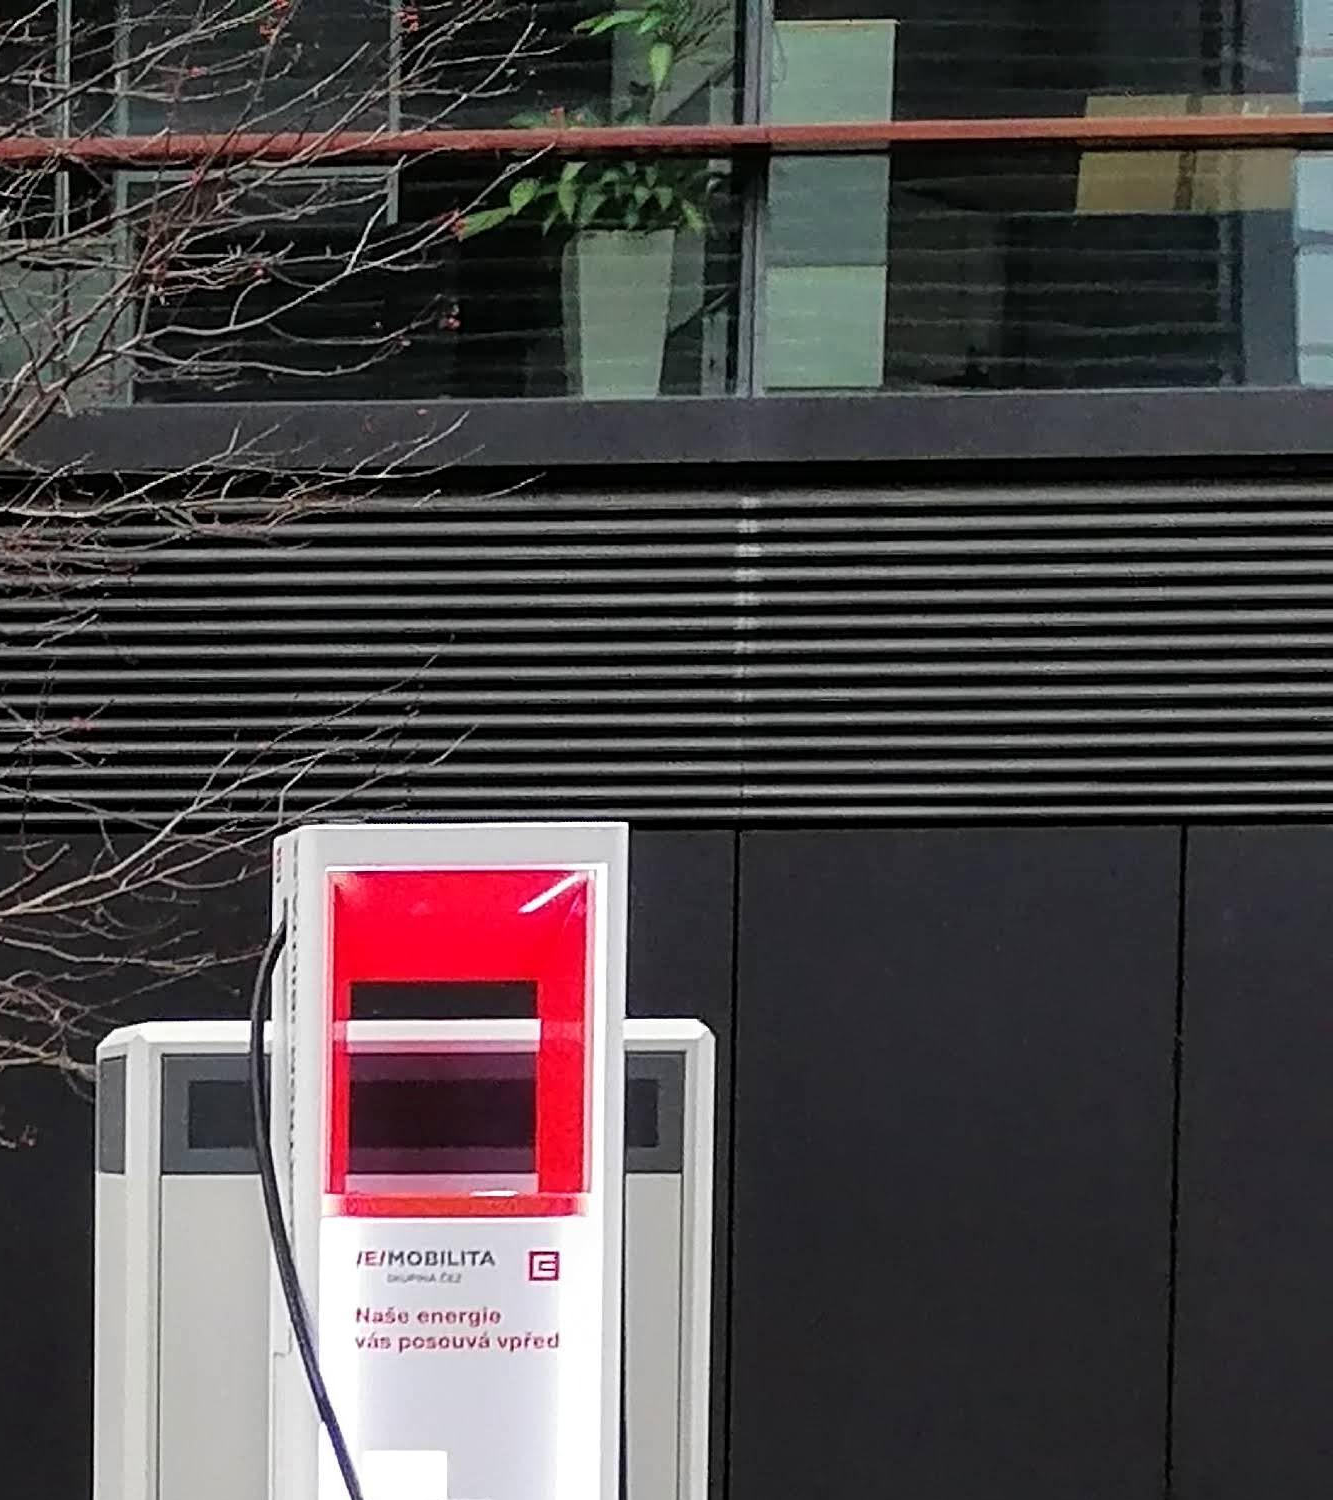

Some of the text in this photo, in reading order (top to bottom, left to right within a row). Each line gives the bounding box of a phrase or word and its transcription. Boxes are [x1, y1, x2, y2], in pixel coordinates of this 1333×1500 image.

[355, 1306, 502, 1328] Naše energie
[355, 1331, 561, 1353] vás posouvá vpřed
